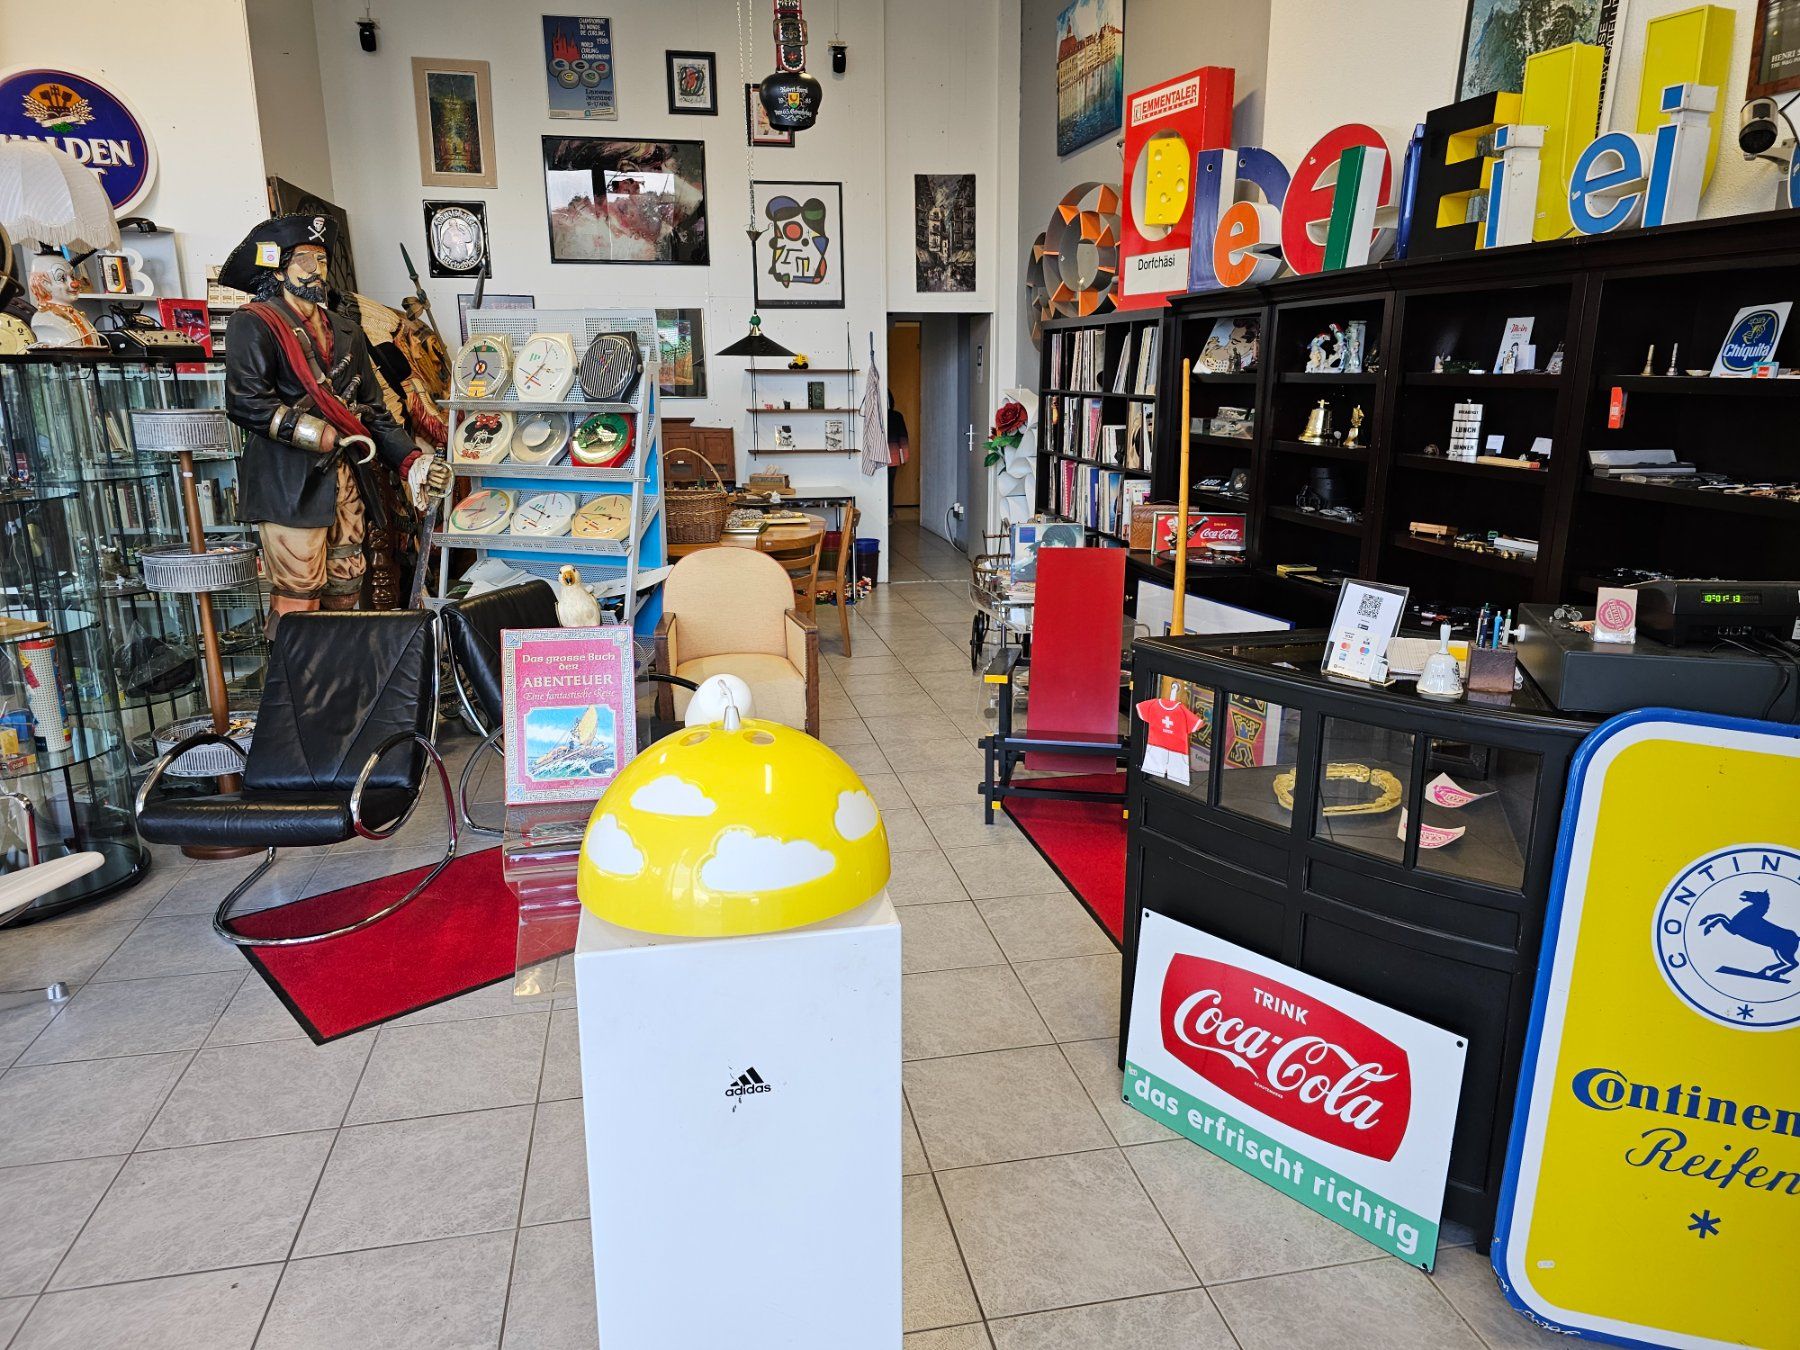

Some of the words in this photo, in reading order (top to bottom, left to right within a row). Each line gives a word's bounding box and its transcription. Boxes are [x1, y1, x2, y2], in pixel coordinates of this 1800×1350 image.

[1142, 84, 1197, 113] EMMENTALER
[1137, 253, 1176, 271] Dorfchäsi
[1723, 342, 1771, 361] Chiquita
[521, 654, 545, 664] Das
[546, 655, 586, 666] grosse
[588, 653, 617, 662] Buch
[523, 674, 614, 689] ABENTEUER
[522, 691, 544, 701] Eine
[545, 688, 591, 703] fantastische
[593, 685, 616, 699] Reise
[1253, 987, 1308, 1026] TRINK
[1173, 989, 1399, 1131] Coca-Cola
[725, 1083, 771, 1097] adidas
[1134, 1075, 1179, 1116] das
[1187, 1108, 1305, 1186] erfrischt
[1313, 1177, 1420, 1256] richtig
